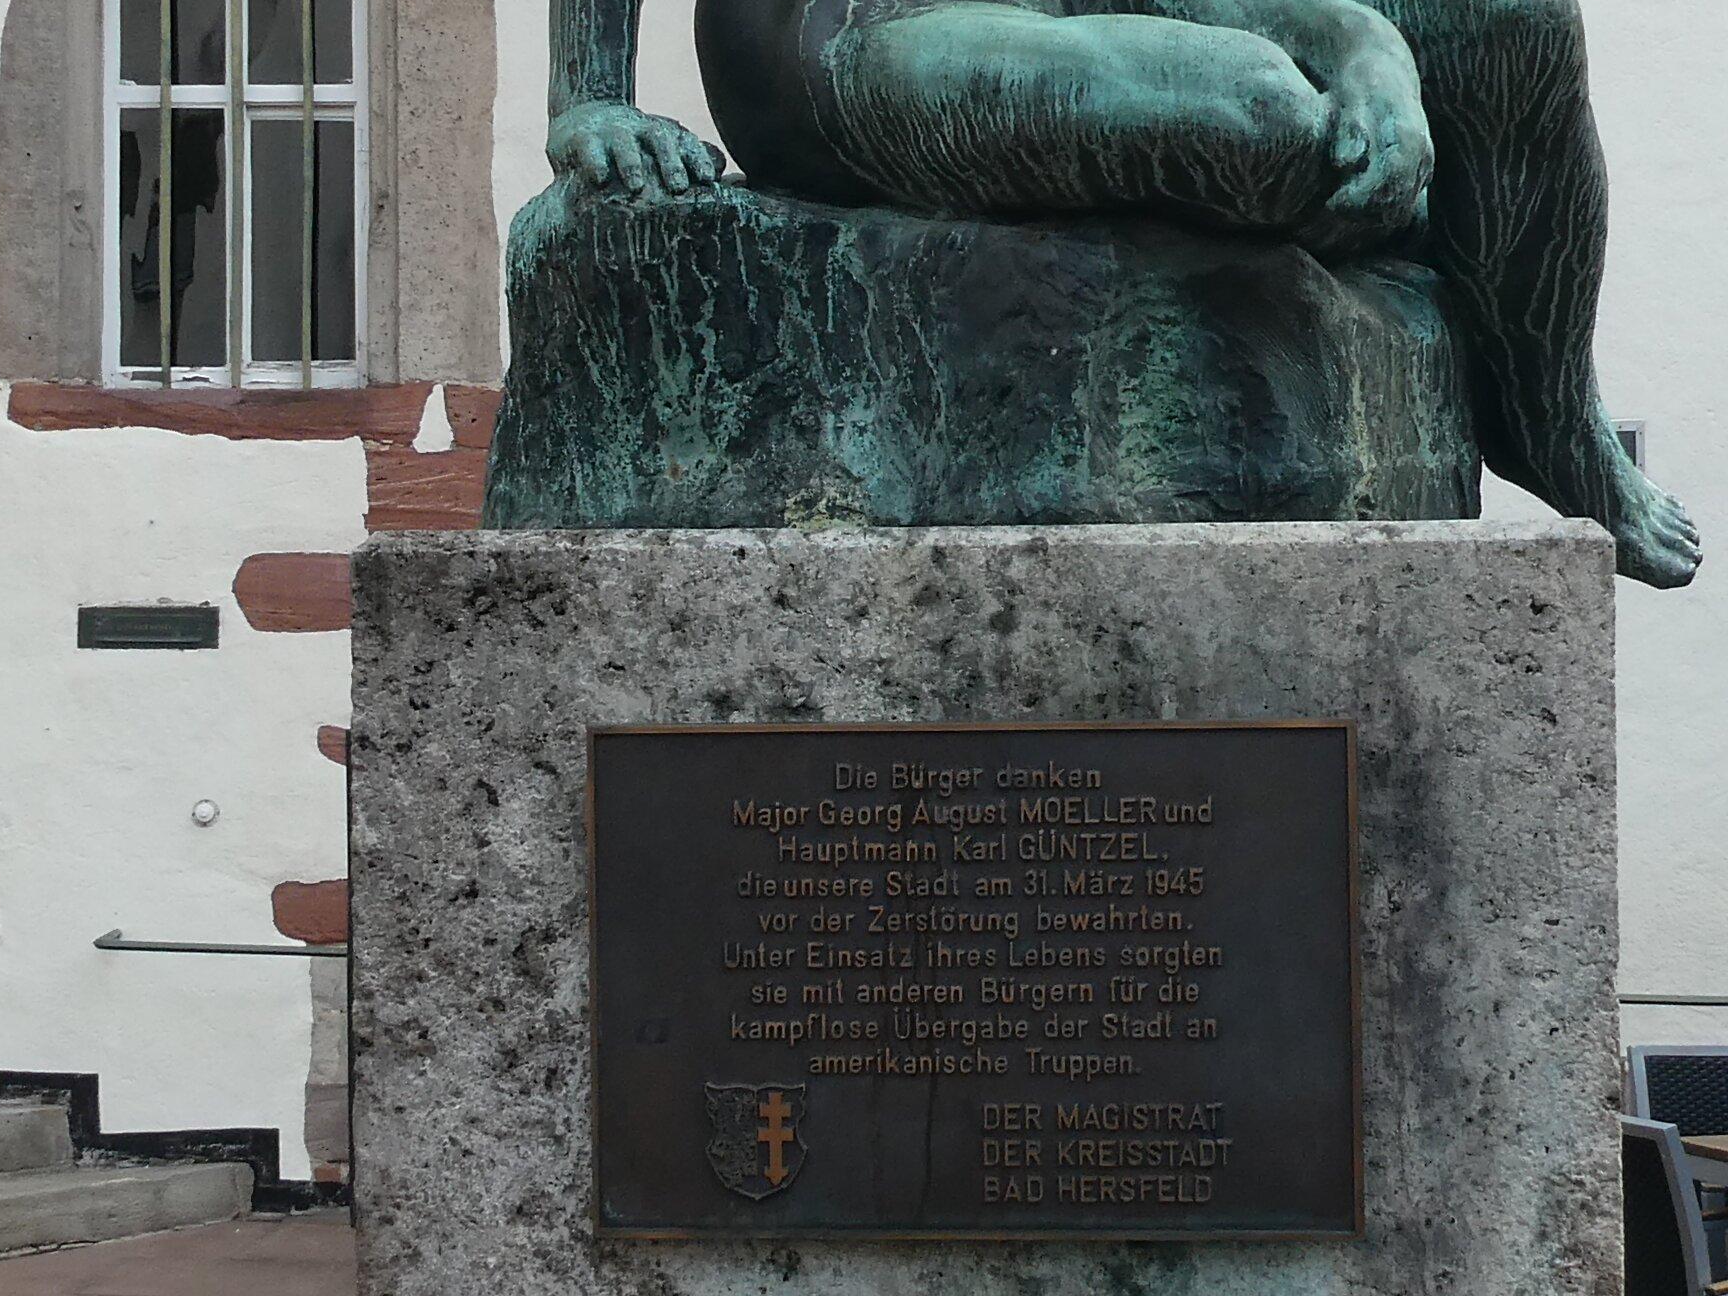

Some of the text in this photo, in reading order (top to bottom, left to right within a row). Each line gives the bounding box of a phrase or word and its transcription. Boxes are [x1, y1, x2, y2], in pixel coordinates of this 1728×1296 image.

[835, 761, 1101, 796] Die Bürger danken
[732, 794, 1212, 833] Major Georg August MOELLER und
[778, 829, 1169, 867] Hauptmann Karl GÜNTZEL,
[738, 866, 1204, 897] die unsere Stadt am 31. März 1945
[759, 903, 1193, 939] vor der Zerstörung bewahrten.
[724, 940, 1223, 974] Unter Einsatz ihres Lebens sorgten
[751, 975, 1200, 1010] sie mit anderen Bürgern für die
[731, 1007, 1217, 1046] kampflose Übergabe der Stadt an
[809, 1047, 1143, 1081] amerikanische Truppen.
[983, 1102, 1223, 1130] DER MAGISTRAT
[983, 1138, 1233, 1166] DER KREISSTADT
[984, 1175, 1212, 1202] BAD HERSFELD
